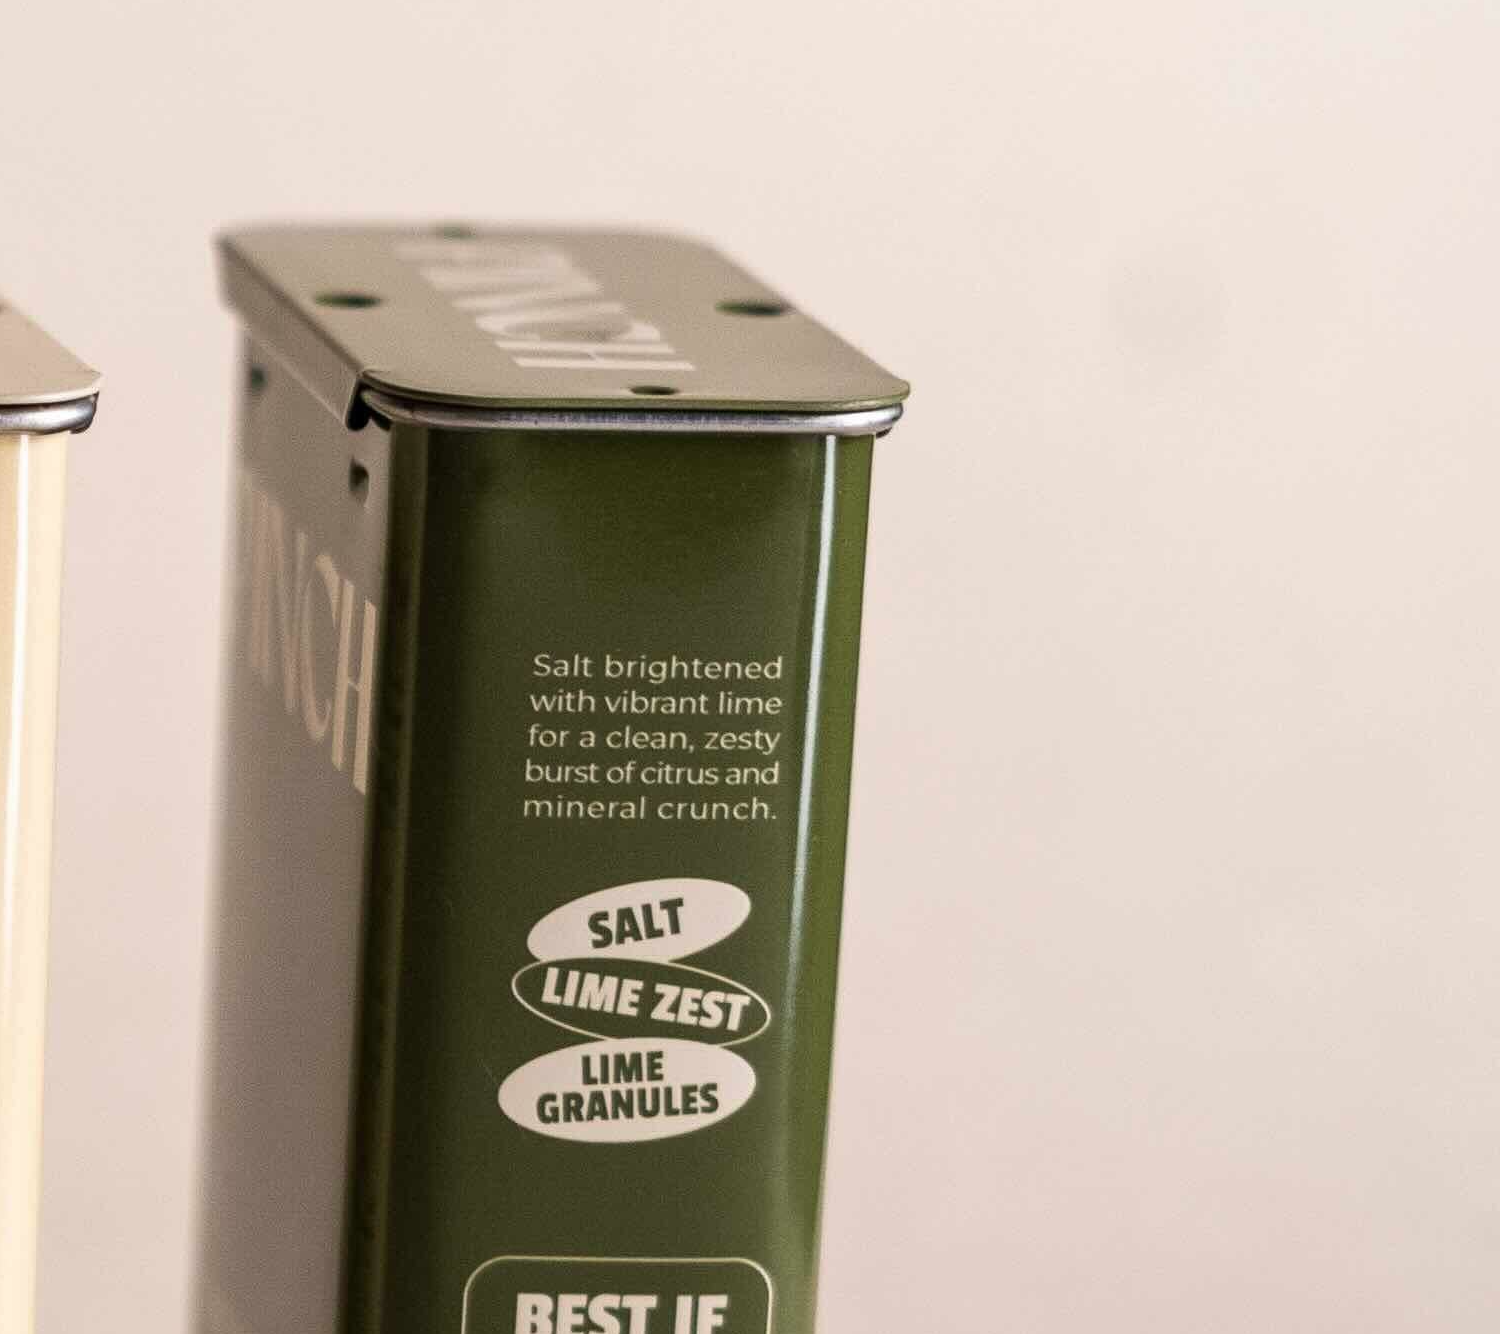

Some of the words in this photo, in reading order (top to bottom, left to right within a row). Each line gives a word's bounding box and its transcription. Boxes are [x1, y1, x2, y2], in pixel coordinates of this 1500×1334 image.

[533, 653, 592, 678] Salt
[604, 654, 783, 685] brightened
[529, 688, 596, 713] with
[604, 689, 709, 715] vibrant
[718, 691, 783, 715] lime
[528, 723, 570, 748] for
[579, 730, 596, 748] a
[605, 725, 695, 753] clean,
[704, 729, 781, 756] zesty
[587, 897, 685, 950] SALT
[540, 967, 645, 1017] LIME
[650, 981, 752, 1032] ZEST
[581, 1050, 665, 1086] LIME
[535, 1082, 720, 1125] GRANULES
